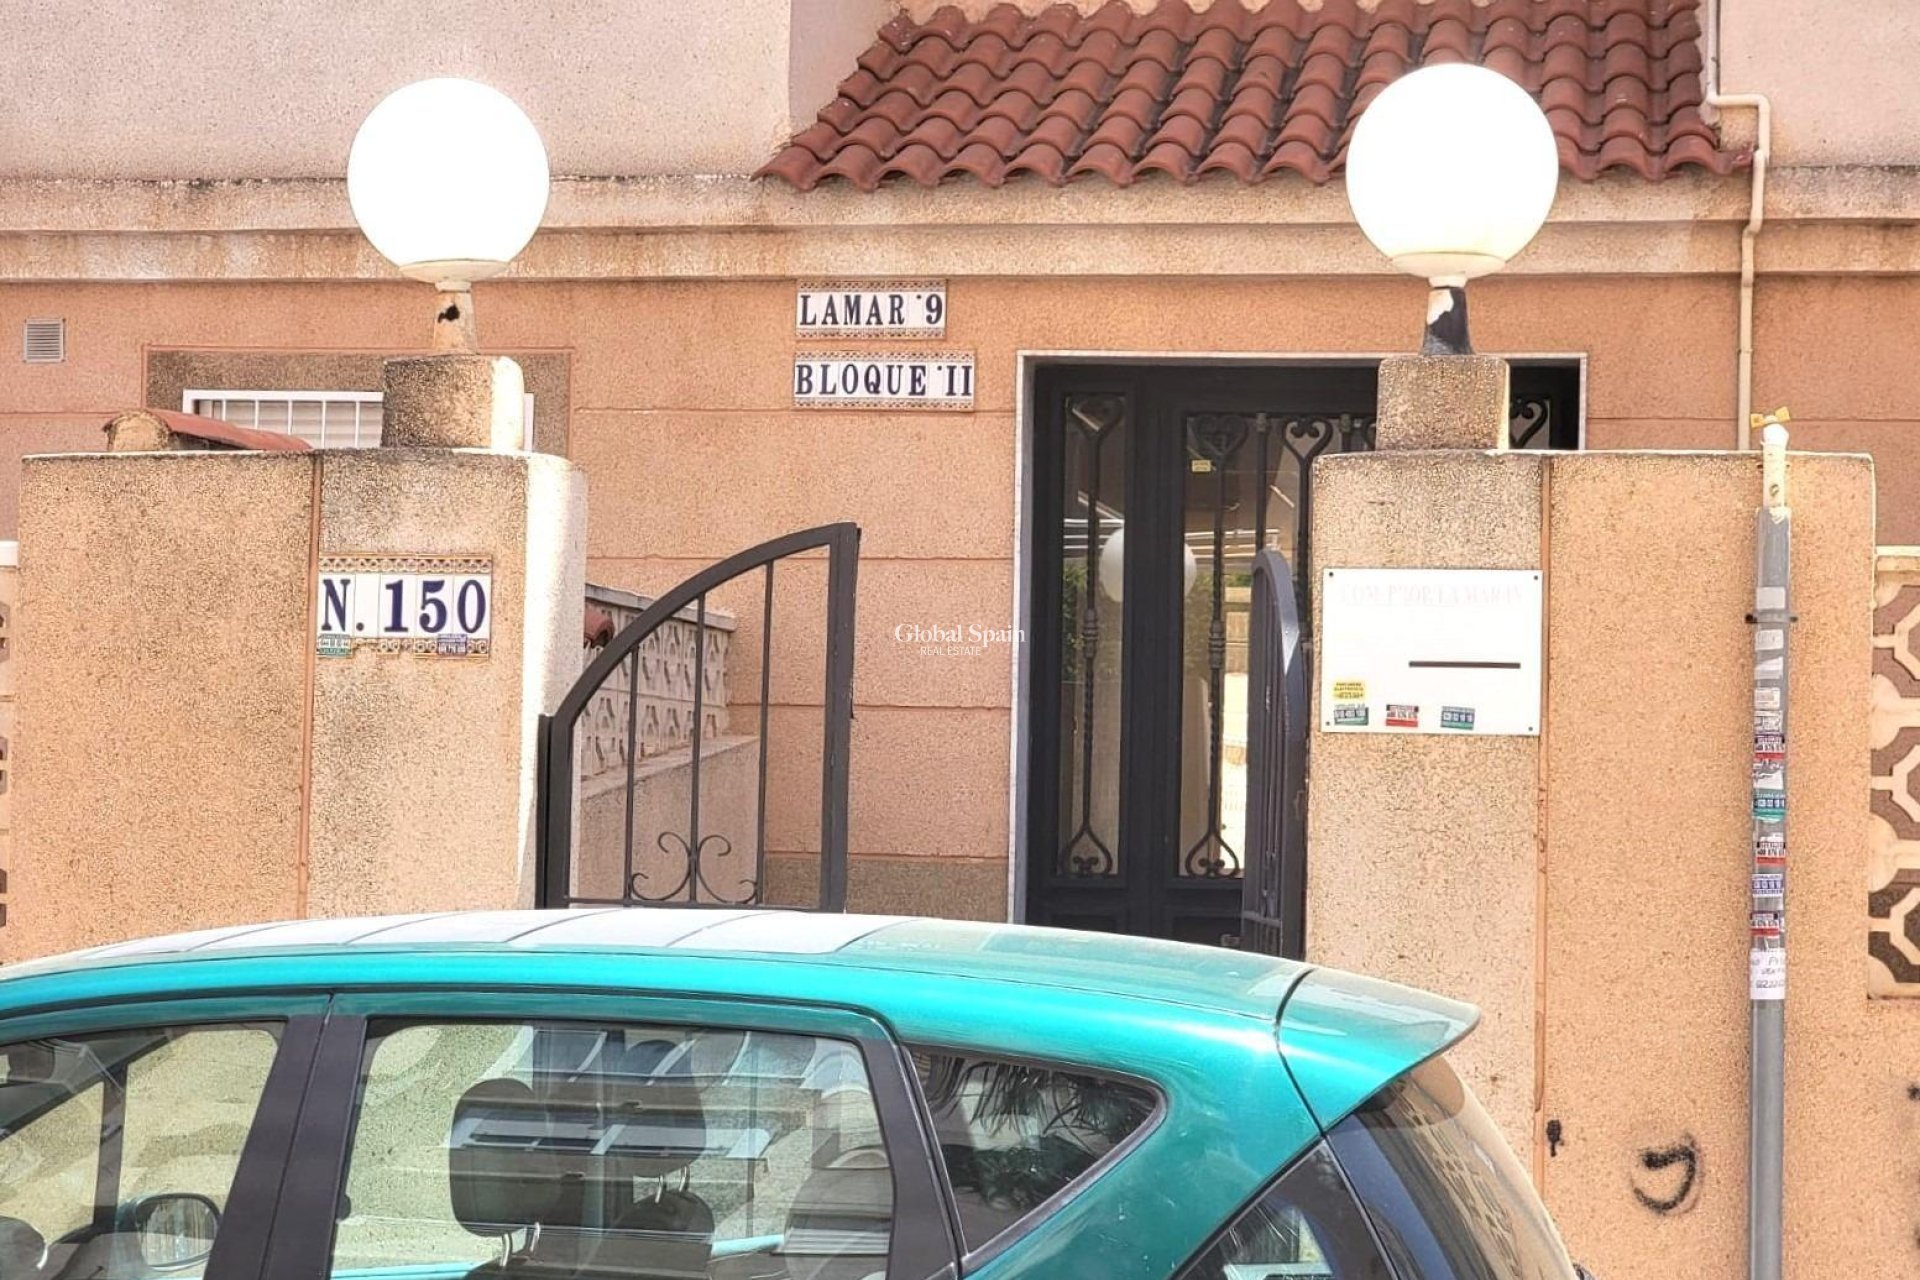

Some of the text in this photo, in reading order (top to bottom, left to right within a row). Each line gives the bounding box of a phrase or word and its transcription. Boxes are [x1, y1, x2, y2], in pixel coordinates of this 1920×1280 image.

[799, 294, 905, 325] LAMAR
[795, 364, 927, 396] BLOQUE
[321, 579, 487, 634] N. 150
